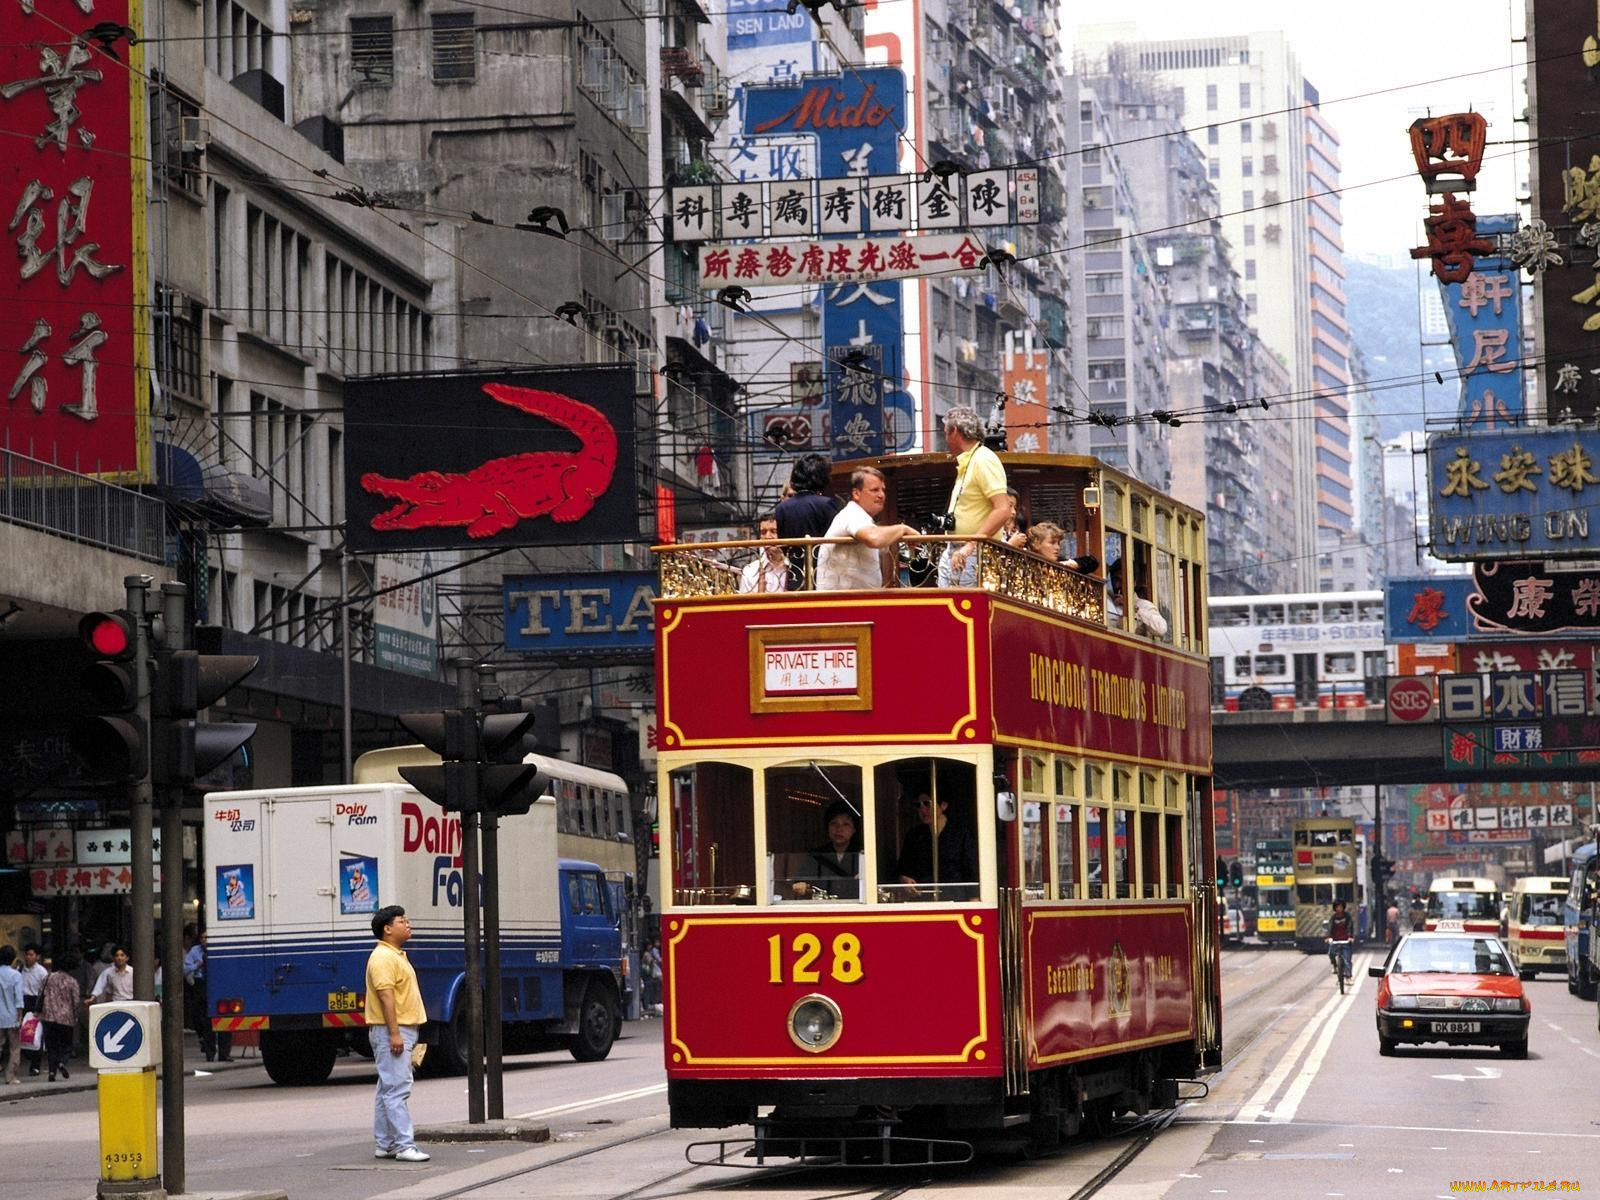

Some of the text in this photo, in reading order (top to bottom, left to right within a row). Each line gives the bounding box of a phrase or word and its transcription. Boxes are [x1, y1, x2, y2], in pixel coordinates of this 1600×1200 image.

[736, 14, 805, 36] SEN LAND
[755, 84, 893, 133] Mido
[1443, 512, 1588, 545] WING ON
[509, 585, 656, 635] TEA
[767, 652, 854, 669] PRIVATE HIRE
[335, 803, 367, 816] Dairy
[348, 815, 377, 826] Farm
[767, 932, 864, 984] 128
[1435, 1023, 1449, 1032] DK
[105, 1153, 143, 1163] 43953
